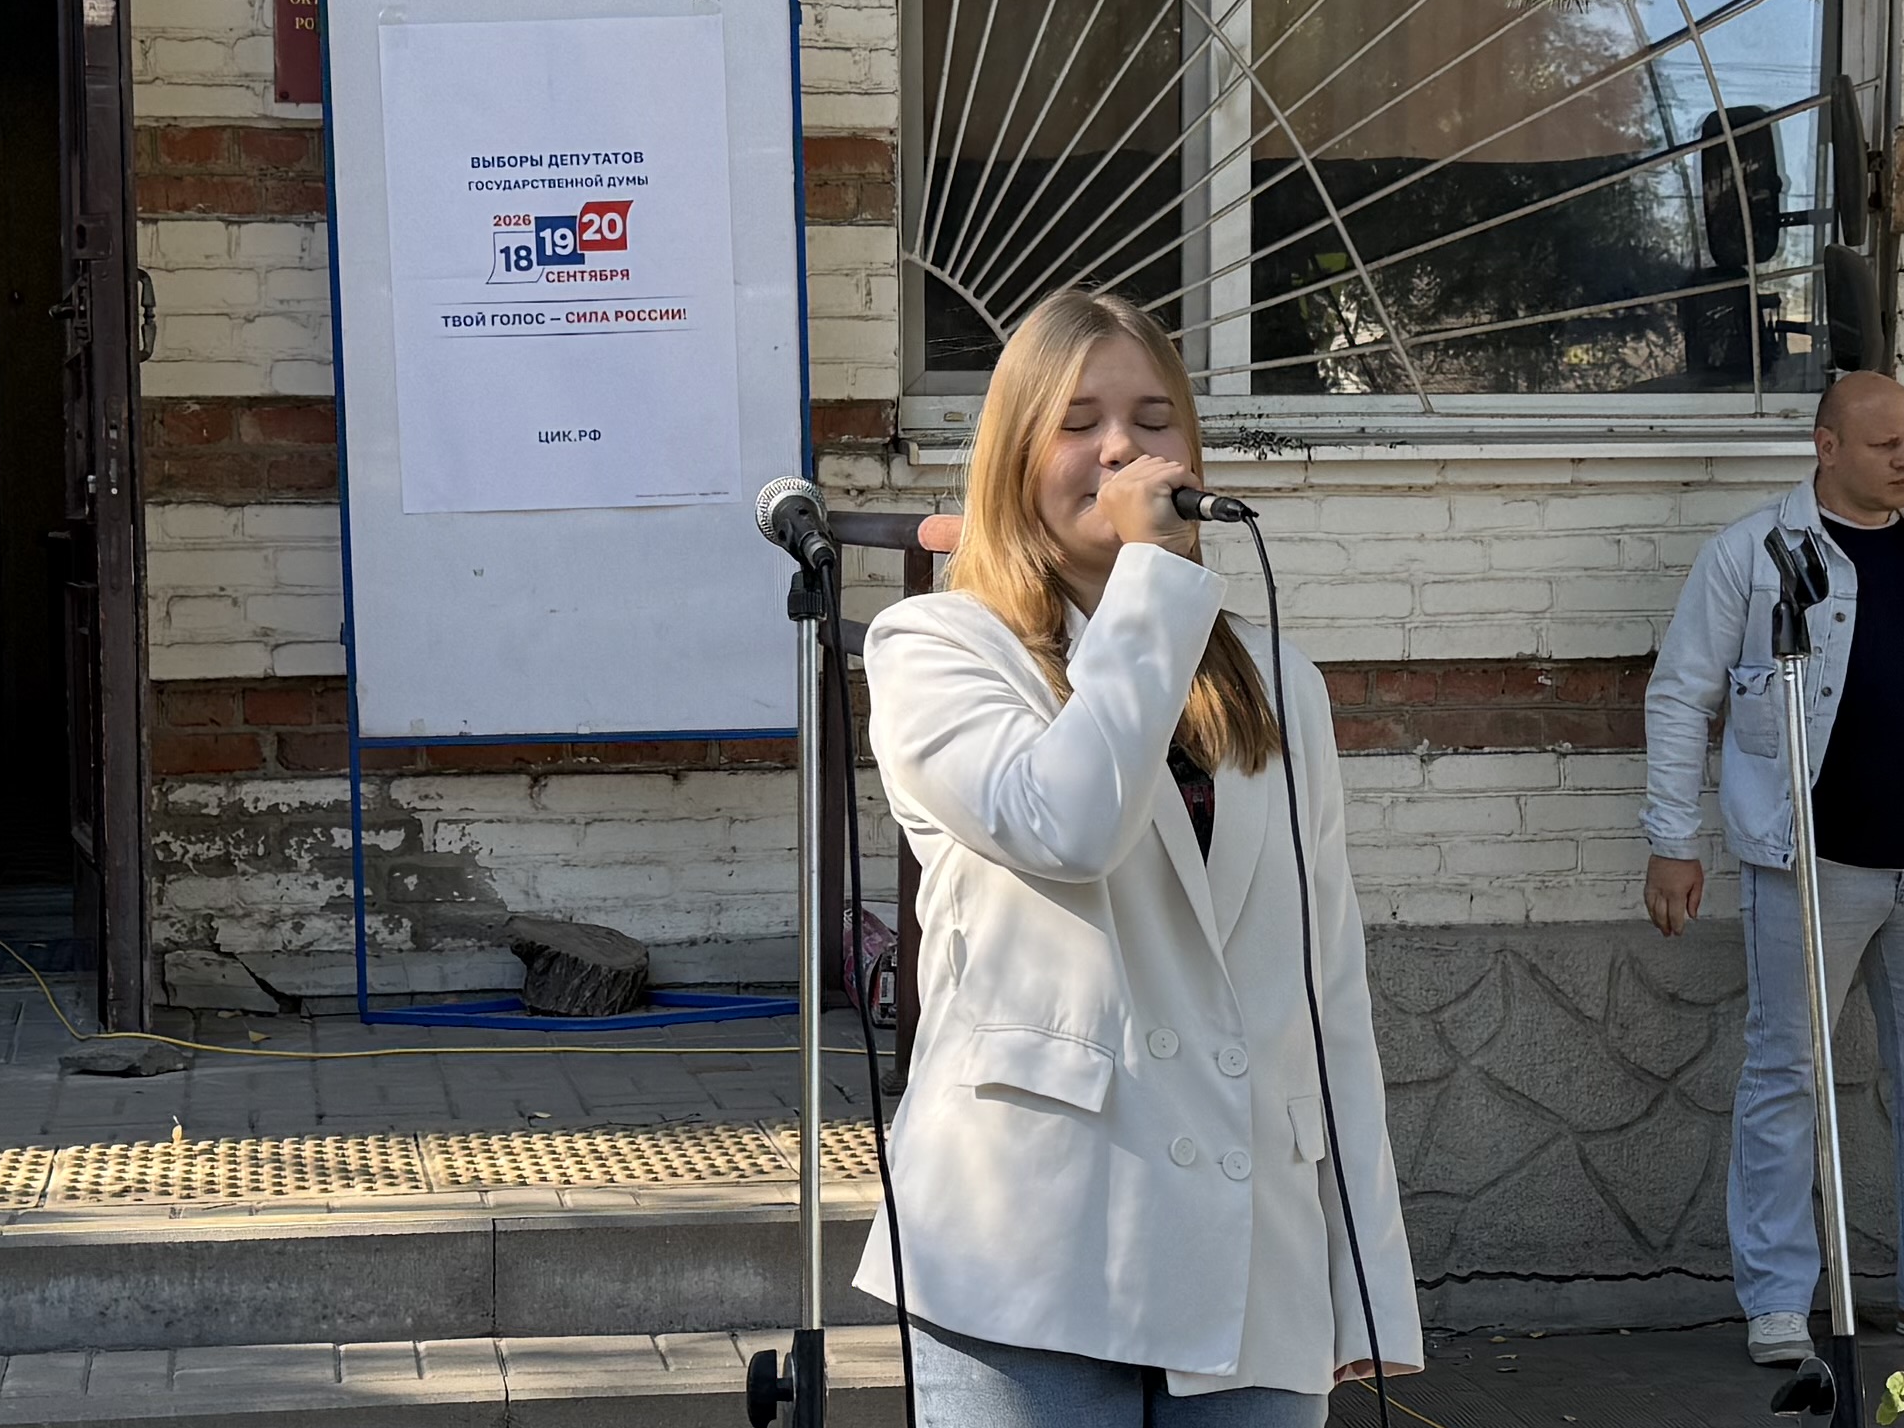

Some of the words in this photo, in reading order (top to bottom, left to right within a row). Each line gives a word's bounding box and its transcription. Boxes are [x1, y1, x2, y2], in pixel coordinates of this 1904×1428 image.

[470, 154, 544, 170] ВЫБОРЫ
[547, 151, 645, 170] ДЕПУТАТОВ
[467, 175, 603, 192] ГОСУДАРСТВЕННОЙ
[606, 175, 649, 190] ДУМЫ
[492, 214, 532, 228] 2026
[499, 245, 534, 273] 18
[539, 227, 576, 257] 19
[581, 211, 624, 242] 20
[544, 268, 631, 284] СЕНТЯБРЯ
[441, 312, 487, 329] ТВОЙ
[490, 312, 546, 328] ГОЛОС
[565, 310, 611, 325] СИЛА
[614, 307, 688, 323] РОССИИ!
[537, 427, 602, 444] ЦИК.РФ
